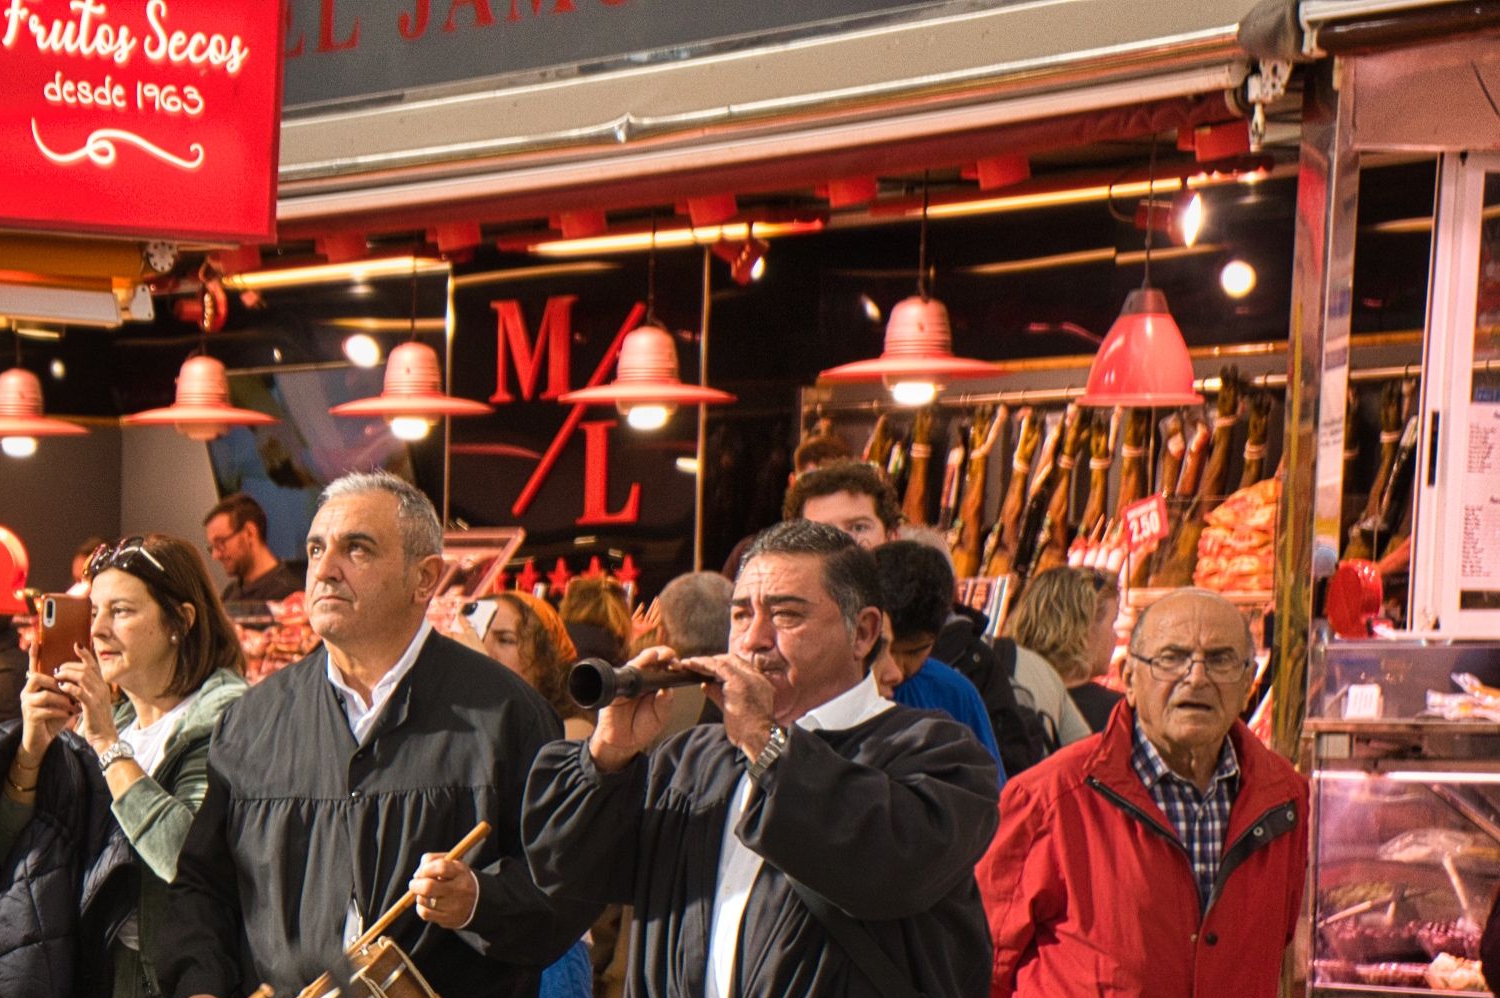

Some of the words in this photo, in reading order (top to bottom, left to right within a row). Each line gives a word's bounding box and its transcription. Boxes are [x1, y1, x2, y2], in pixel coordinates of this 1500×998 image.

[1, 0, 137, 64] Frutos
[143, 0, 250, 73] Secos
[43, 70, 127, 108] desde
[136, 79, 205, 115] 1963
